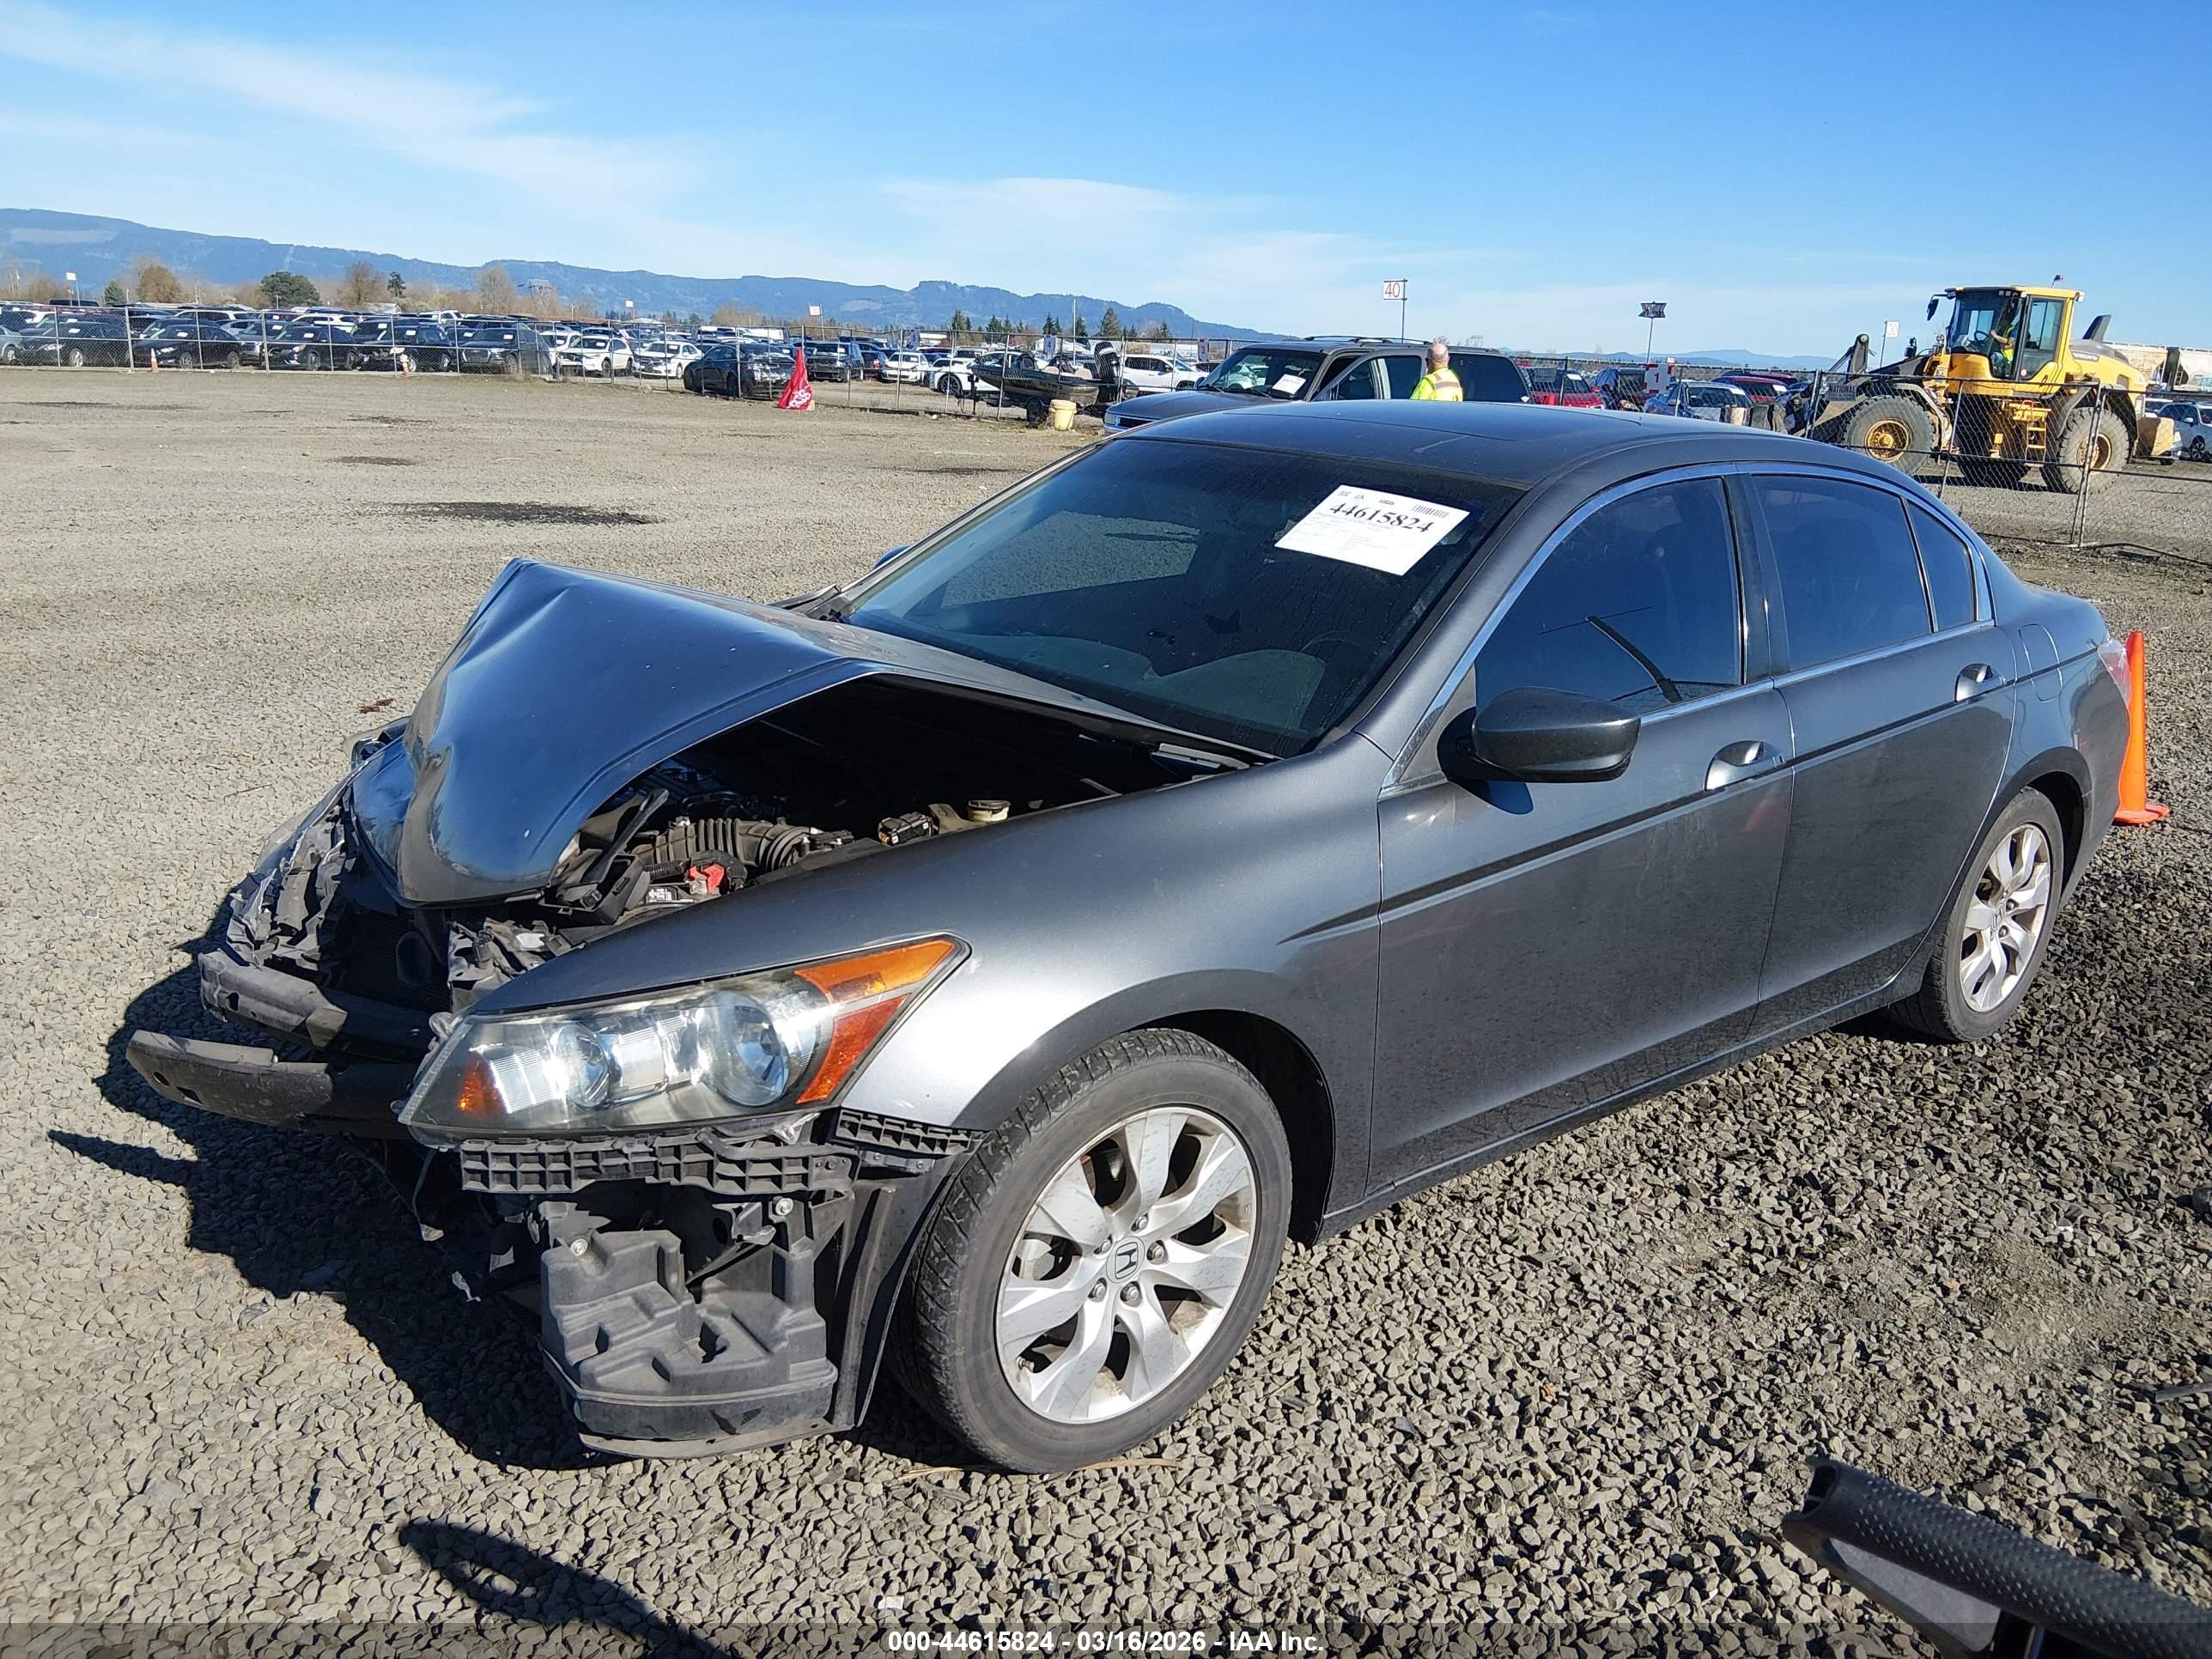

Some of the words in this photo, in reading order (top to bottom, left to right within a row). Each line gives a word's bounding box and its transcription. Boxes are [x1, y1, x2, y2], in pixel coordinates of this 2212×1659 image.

[1385, 283, 1401, 298] 40
[1654, 373, 1659, 383] 1
[1828, 384, 1855, 393] NATIONAL
[1330, 502, 1434, 532] 44615824
